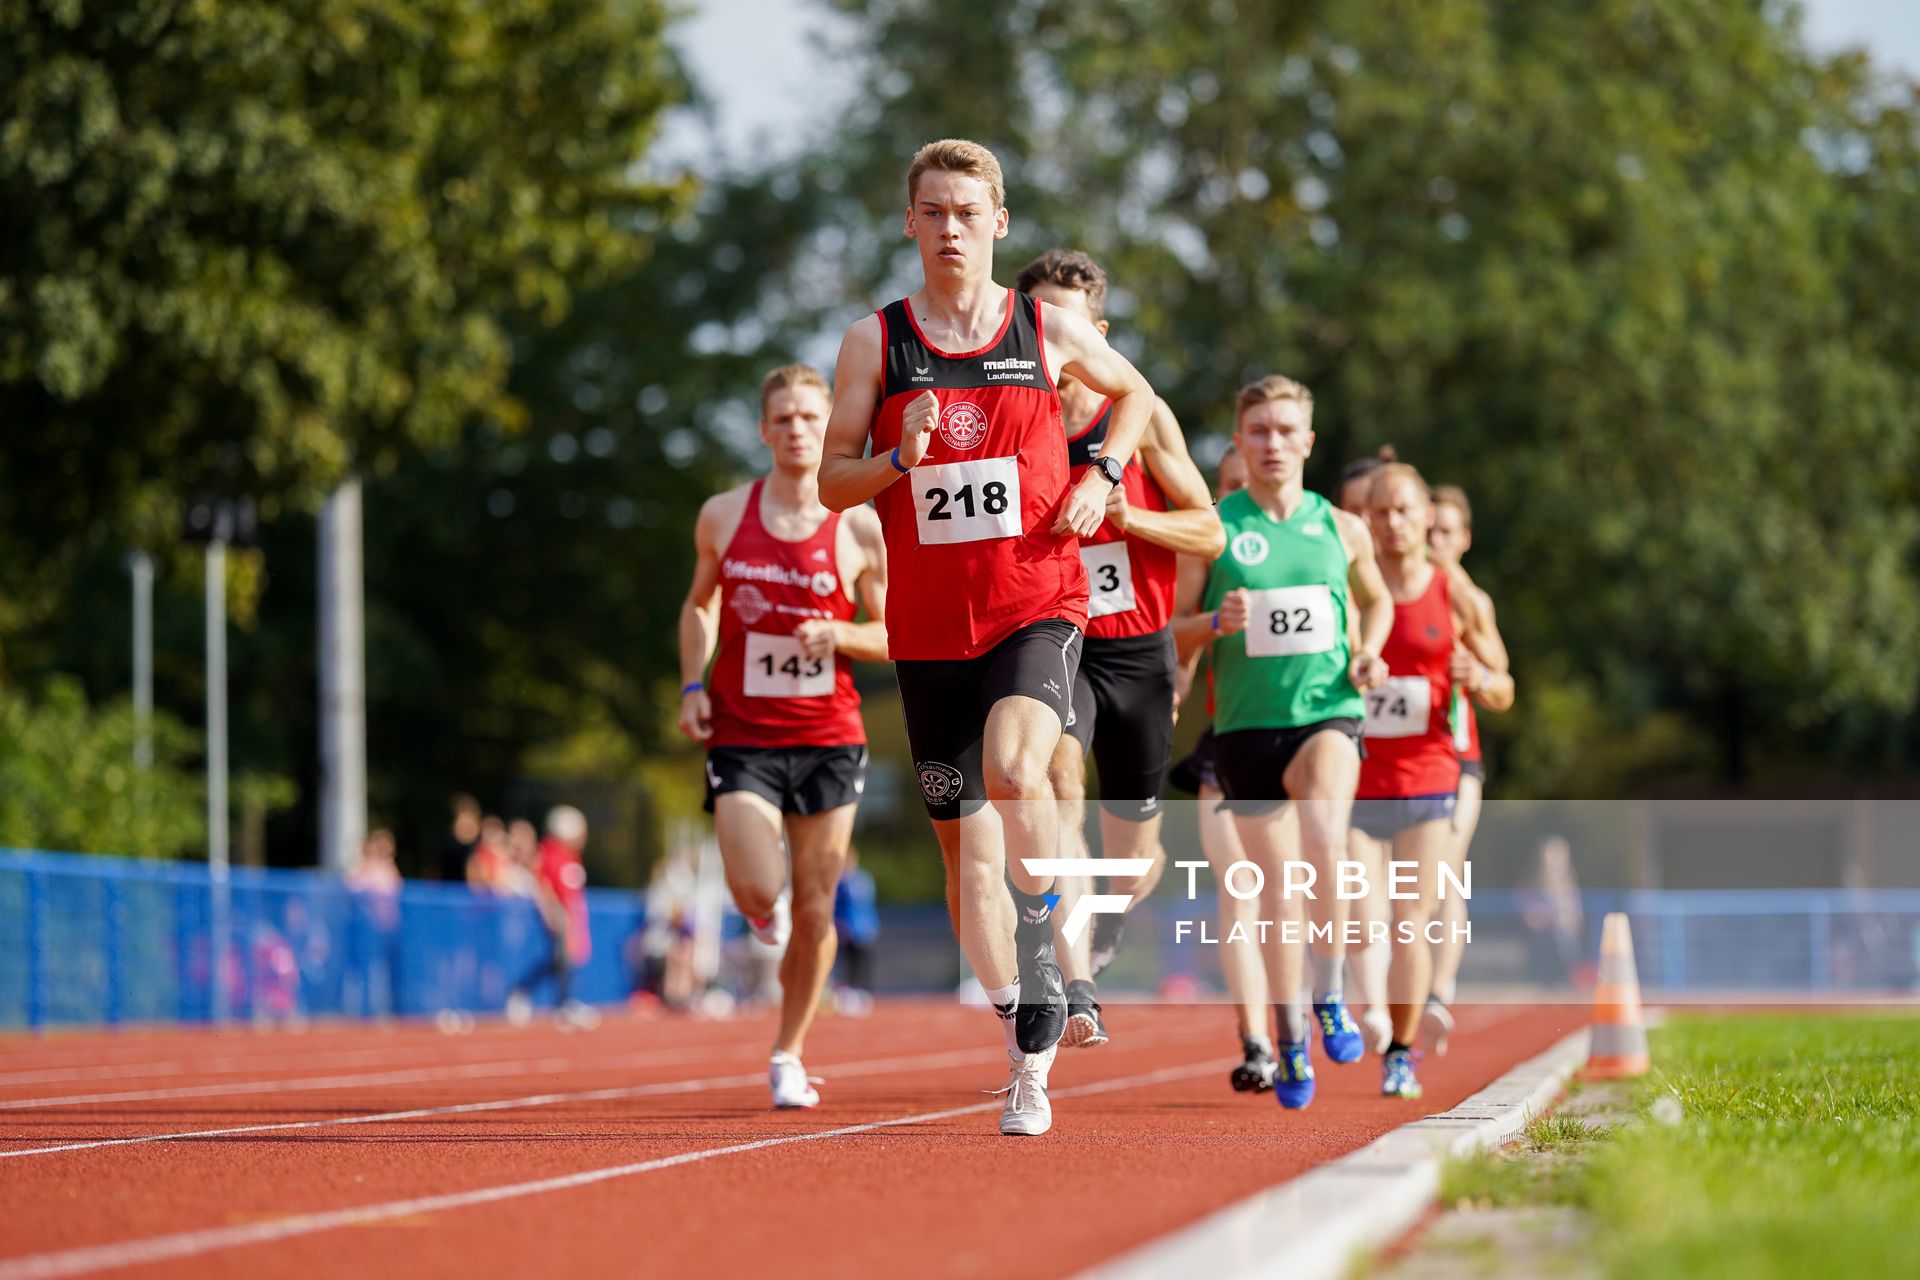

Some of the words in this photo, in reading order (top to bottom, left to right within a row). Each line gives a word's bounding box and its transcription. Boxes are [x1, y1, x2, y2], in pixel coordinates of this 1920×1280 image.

[987, 372, 1034, 381] Laufanalyse
[941, 422, 948, 431] L
[978, 422, 986, 431] G
[925, 481, 1008, 521] 218
[1097, 564, 1120, 592] 3
[1269, 608, 1313, 635] 82
[759, 653, 823, 679] 143
[1368, 695, 1409, 717] 74
